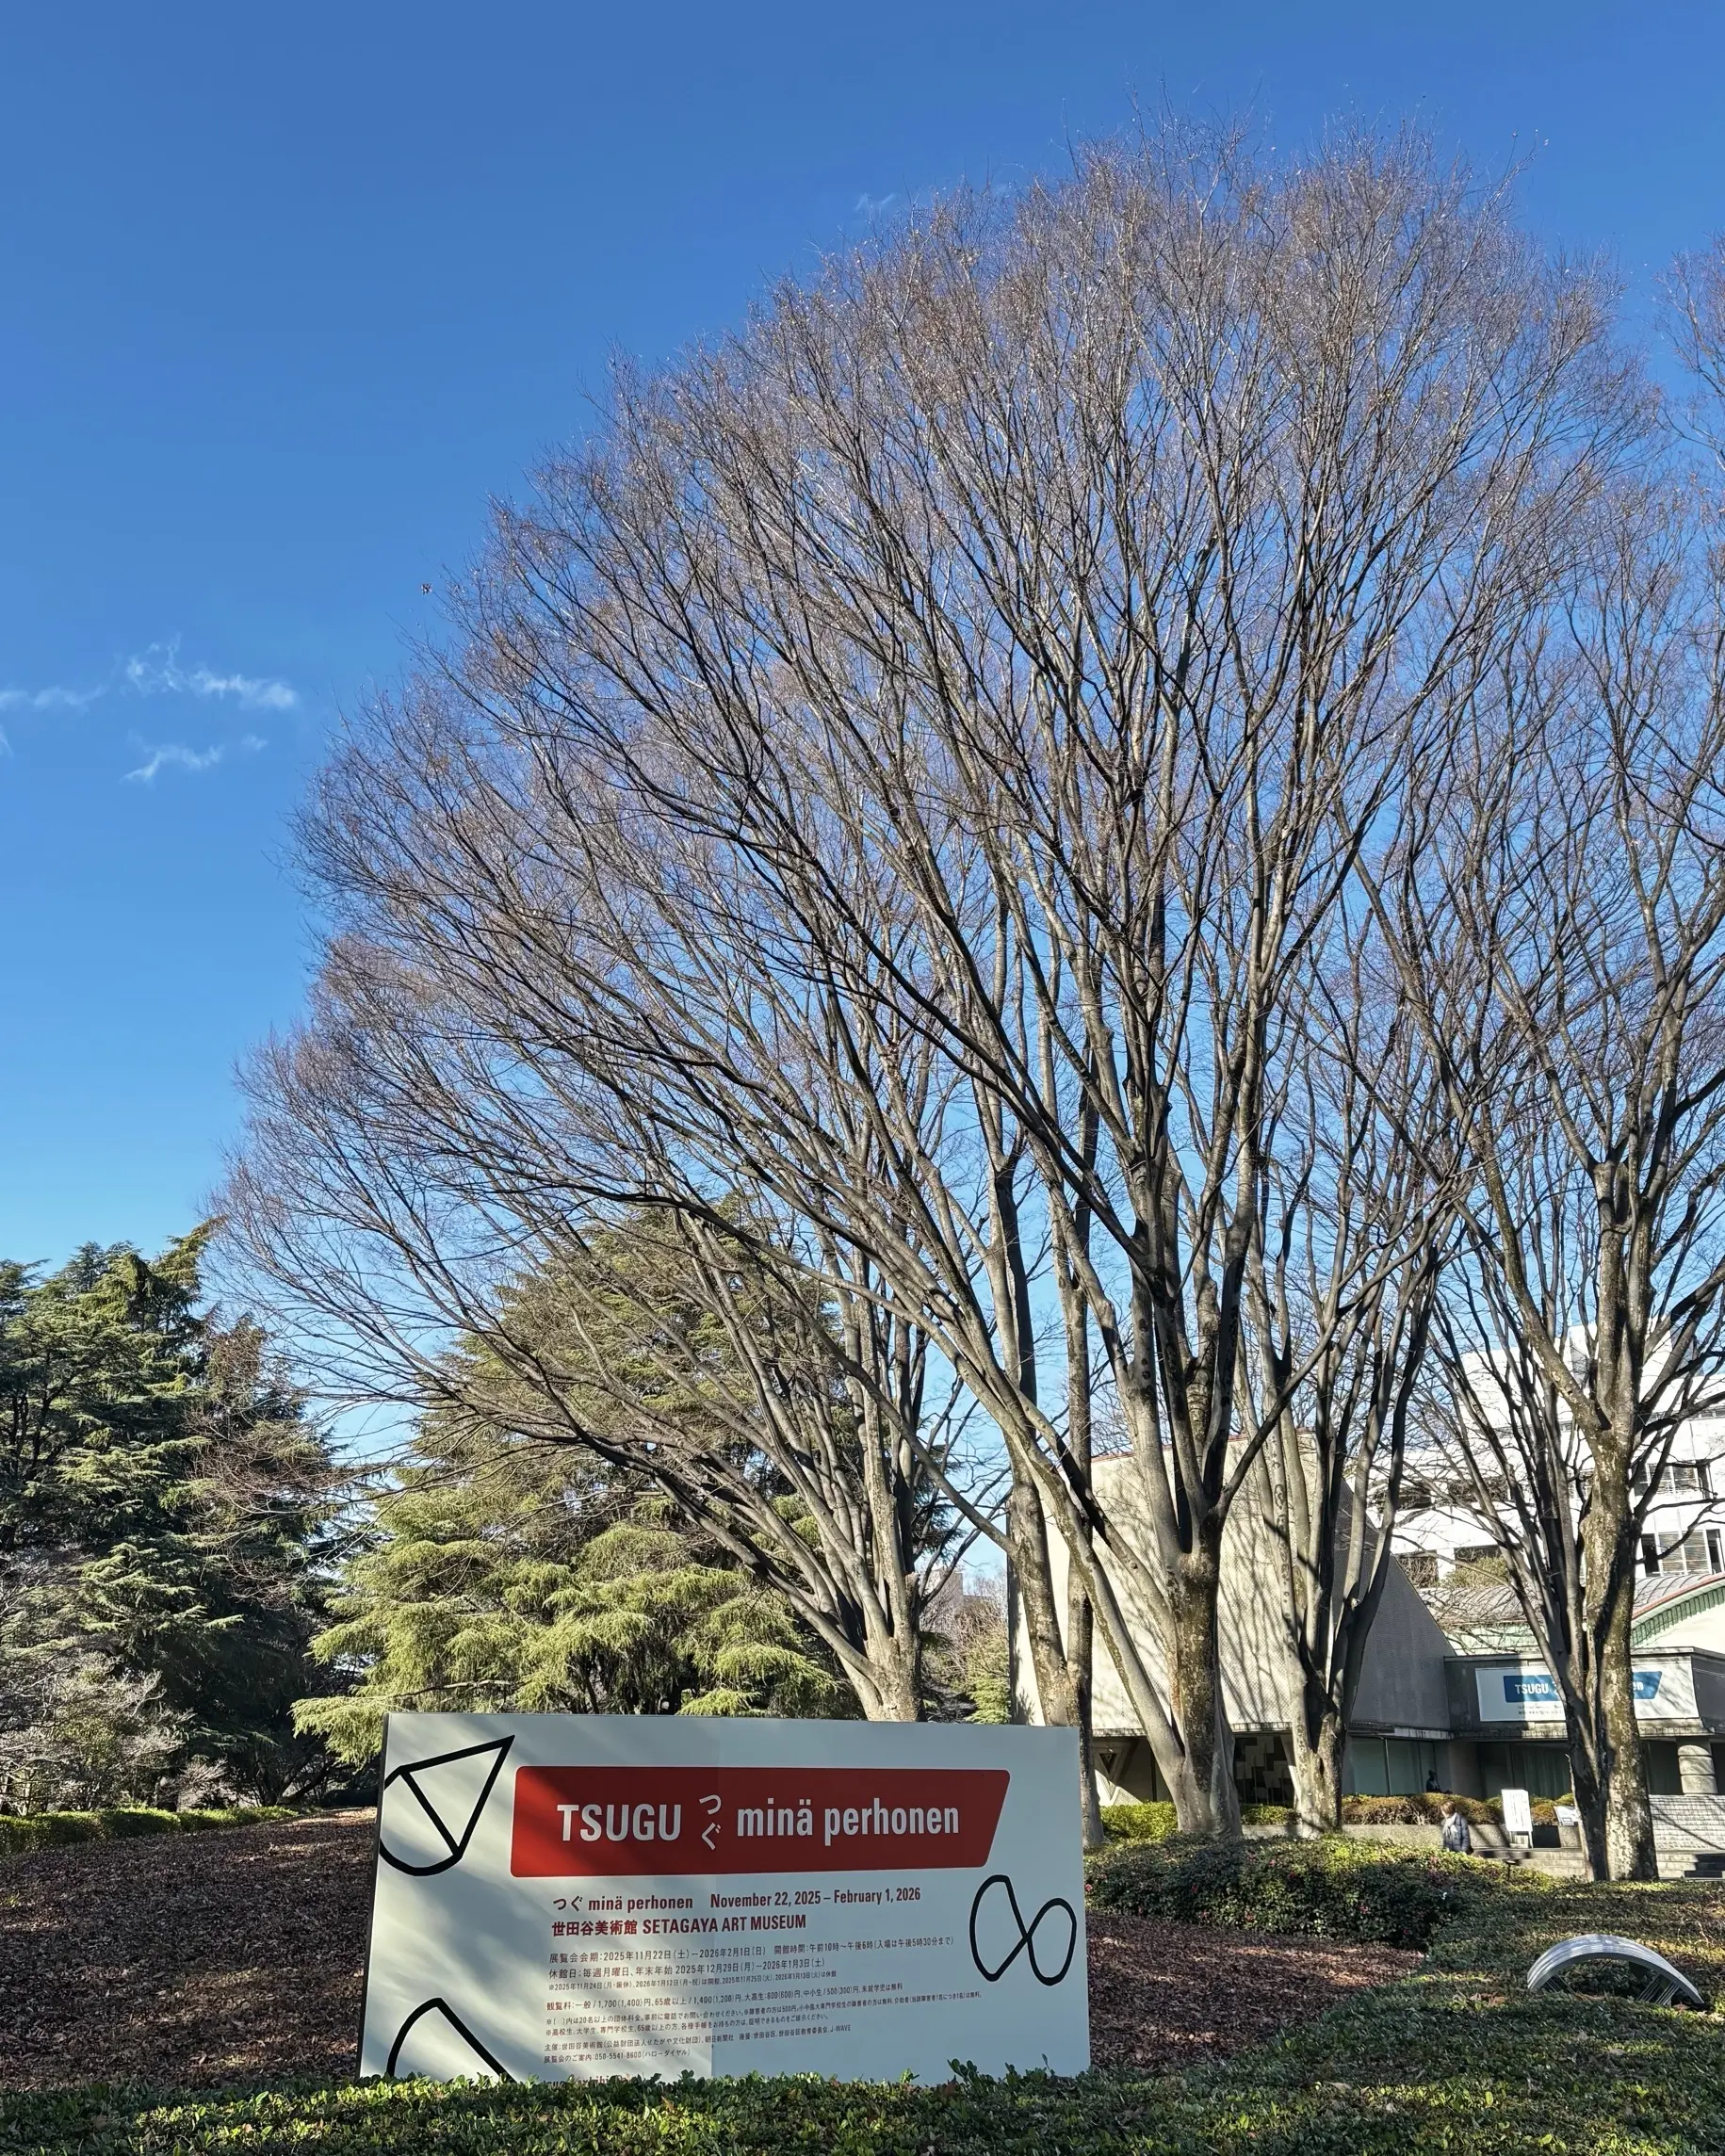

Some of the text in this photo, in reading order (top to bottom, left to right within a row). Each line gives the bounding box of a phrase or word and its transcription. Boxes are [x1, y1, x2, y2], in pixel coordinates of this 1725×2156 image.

[1515, 1683, 1549, 1694] TSUGU
[557, 1794, 959, 1850] TSUGU つぐ minä perhonen
[553, 1895, 583, 1911] つぐ
[588, 1895, 623, 1911] minä
[627, 1894, 693, 1913] perhonen
[710, 1892, 772, 1908] November
[774, 1891, 792, 1907] 22,
[794, 1890, 821, 1905] 2025
[834, 1889, 882, 1905] February
[885, 1888, 894, 1904] 1,
[896, 1887, 921, 1902] 2026
[551, 1914, 806, 1937] 世田谷美術館 SETAGAYA ART MUSEUM
